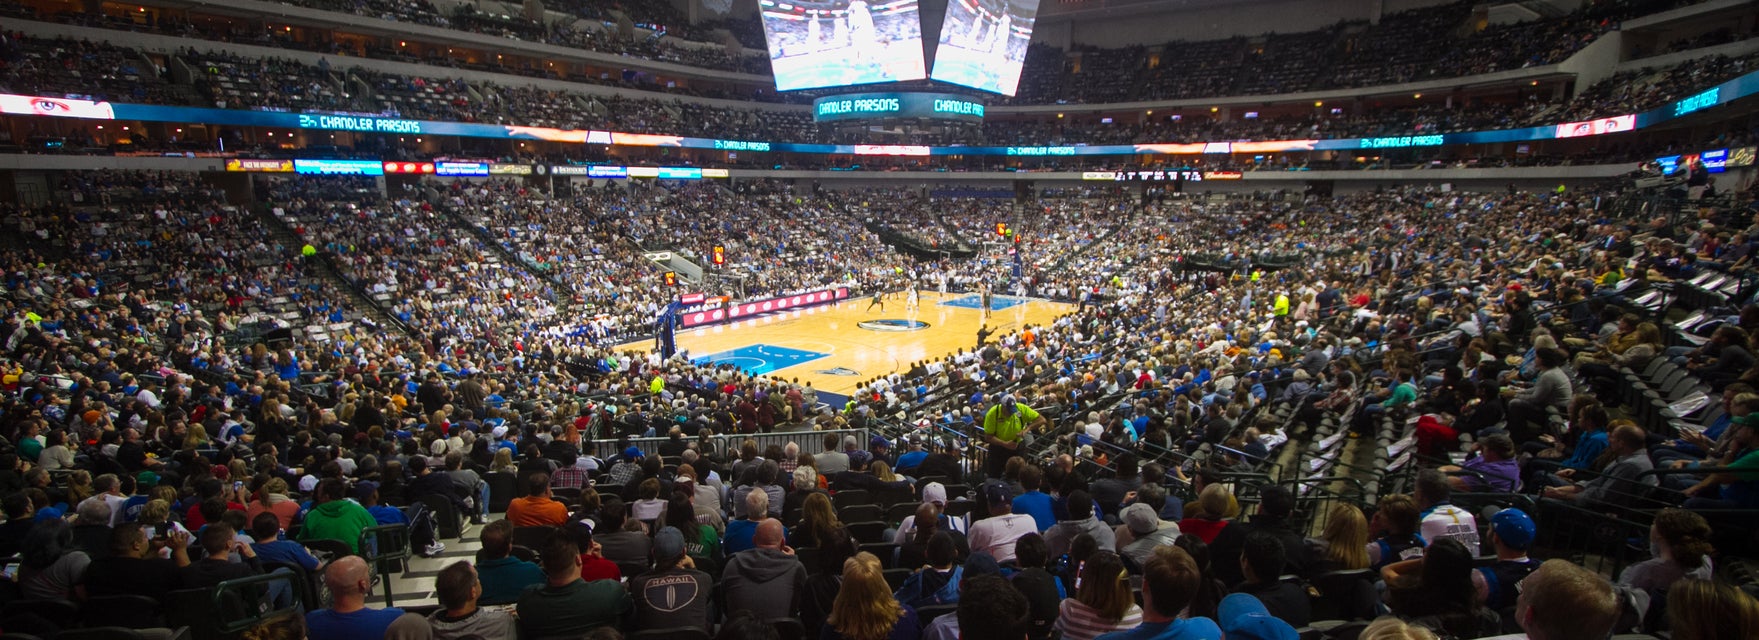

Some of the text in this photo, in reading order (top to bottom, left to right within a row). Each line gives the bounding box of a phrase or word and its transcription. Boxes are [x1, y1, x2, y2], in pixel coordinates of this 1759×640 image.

[854, 98, 900, 112] PARSONS
[934, 99, 972, 115] CHANDLER
[320, 115, 373, 130] CHANDLER
[376, 119, 421, 133] PARSONS
[723, 140, 747, 150] CHANDLER
[747, 141, 770, 151] PARSONS
[1372, 136, 1411, 148] CHANDLER
[1411, 135, 1444, 146] PARSONS
[1017, 146, 1047, 155] CHANDLER
[1047, 146, 1075, 155] PARSONS
[1203, 171, 1242, 180] Budweiser
[652, 576, 690, 585] HAWAII
